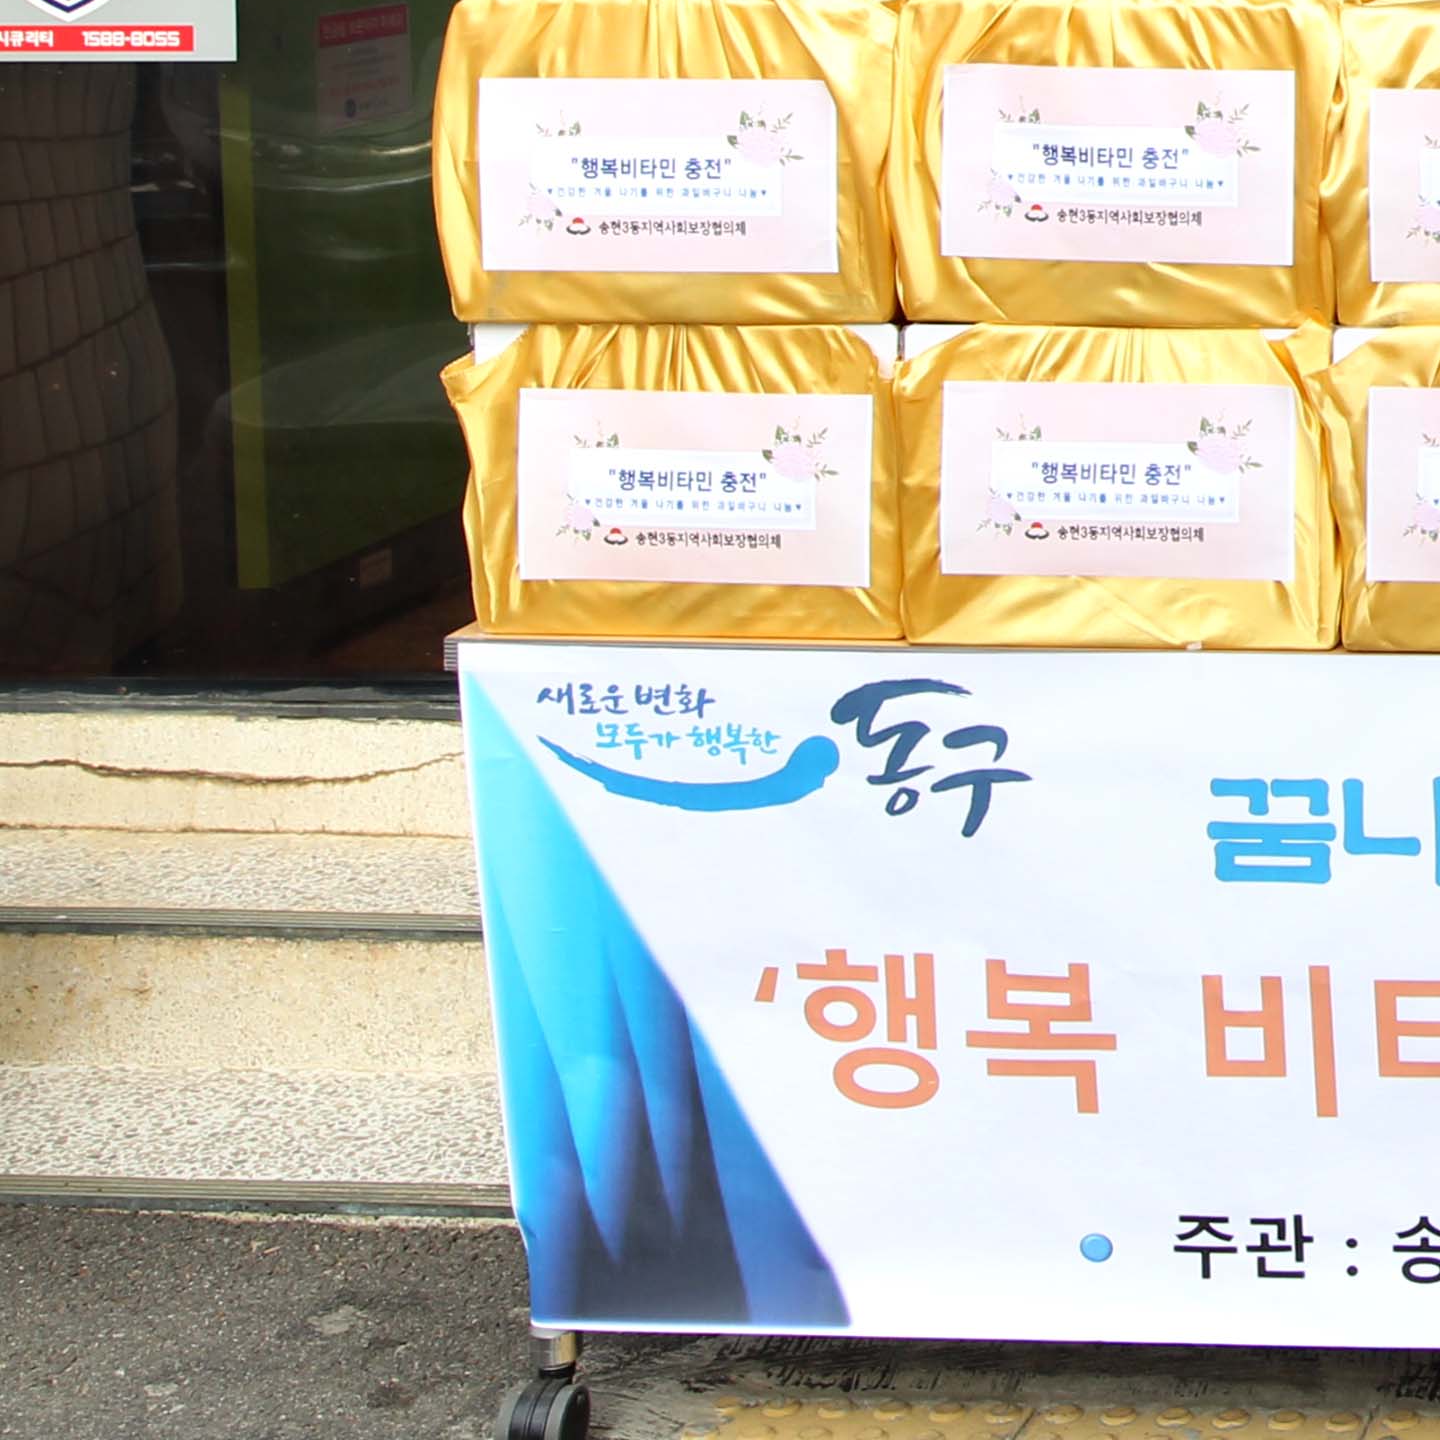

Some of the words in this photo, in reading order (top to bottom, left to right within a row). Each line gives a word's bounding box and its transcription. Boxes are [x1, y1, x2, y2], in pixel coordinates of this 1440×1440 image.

[684, 158, 732, 181] 충전"
[1142, 147, 1189, 171] 충전"
[599, 221, 747, 236] 송현3동지역사회보장협의체
[1057, 209, 1201, 227] 송현3동지역사회보장협의체
[720, 472, 767, 495] 충전"
[1144, 464, 1191, 487] 충전"
[636, 532, 781, 549] 송현3동지역사회보장협의체
[1057, 526, 1205, 542] 송현3동지역사회보장협의체
[535, 680, 632, 720] 새로운
[634, 680, 716, 720] 변화
[682, 720, 782, 766] 행복한
[826, 678, 1032, 838] 동구
[1173, 1214, 1314, 1280] 주관
